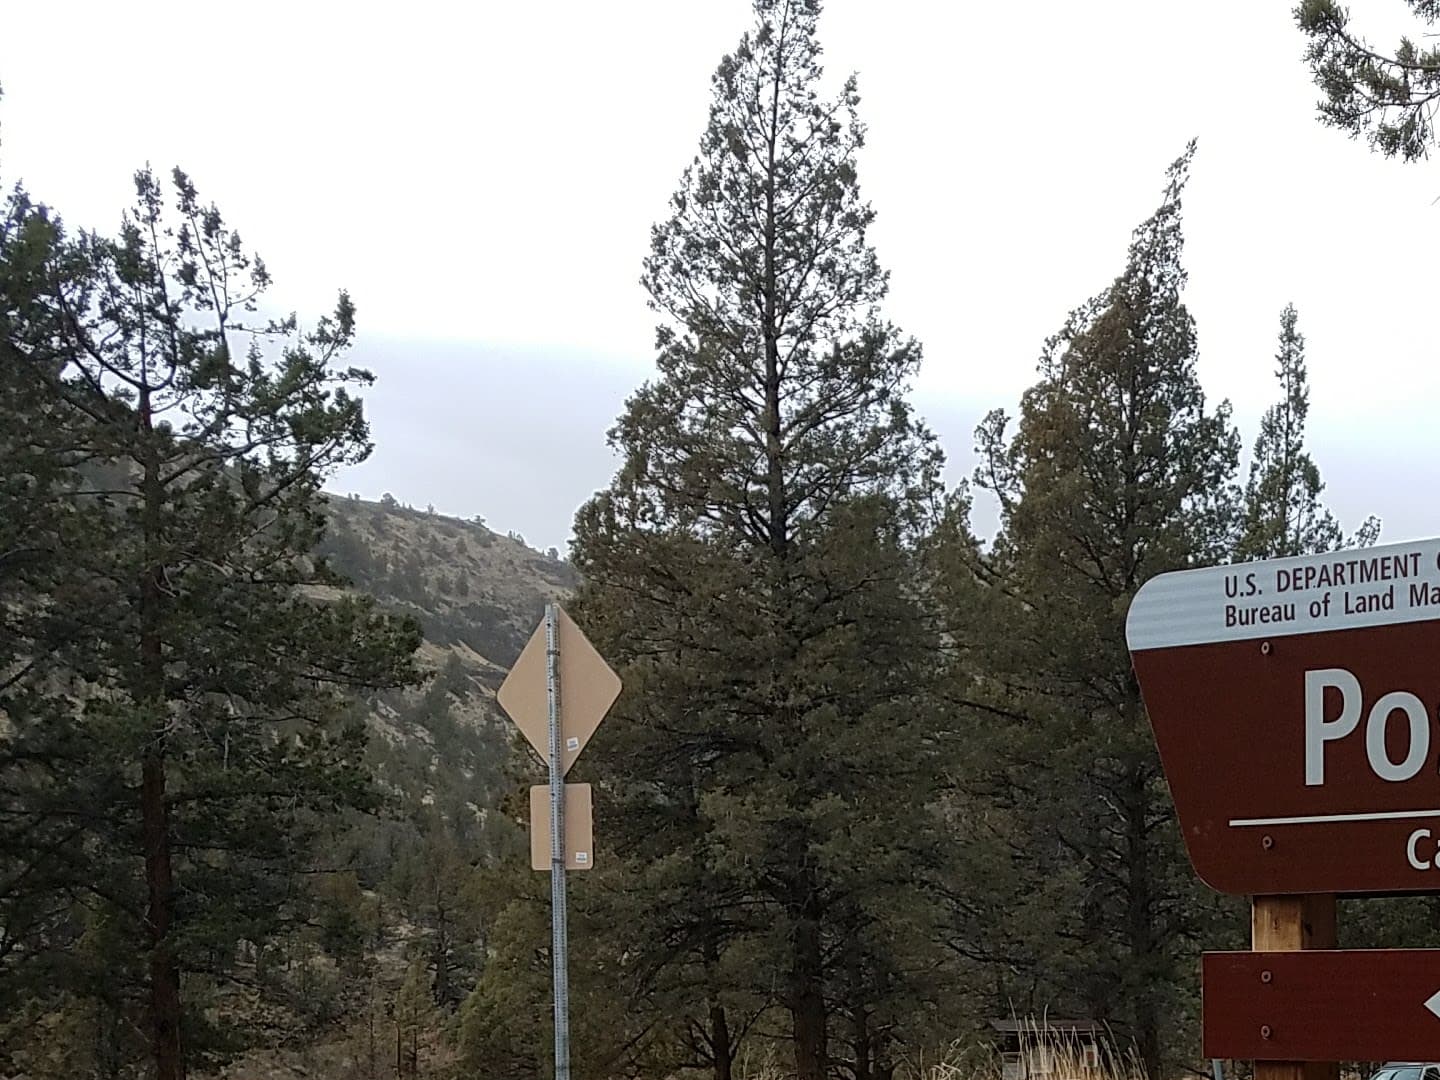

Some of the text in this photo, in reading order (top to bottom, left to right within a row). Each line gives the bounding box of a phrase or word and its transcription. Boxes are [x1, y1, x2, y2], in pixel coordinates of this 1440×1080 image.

[1225, 573, 1262, 598] U.S.
[1277, 552, 1422, 593] DEPARTMENT
[1226, 603, 1295, 627] Bureau
[1310, 592, 1330, 618] of
[1345, 585, 1394, 615] Land
